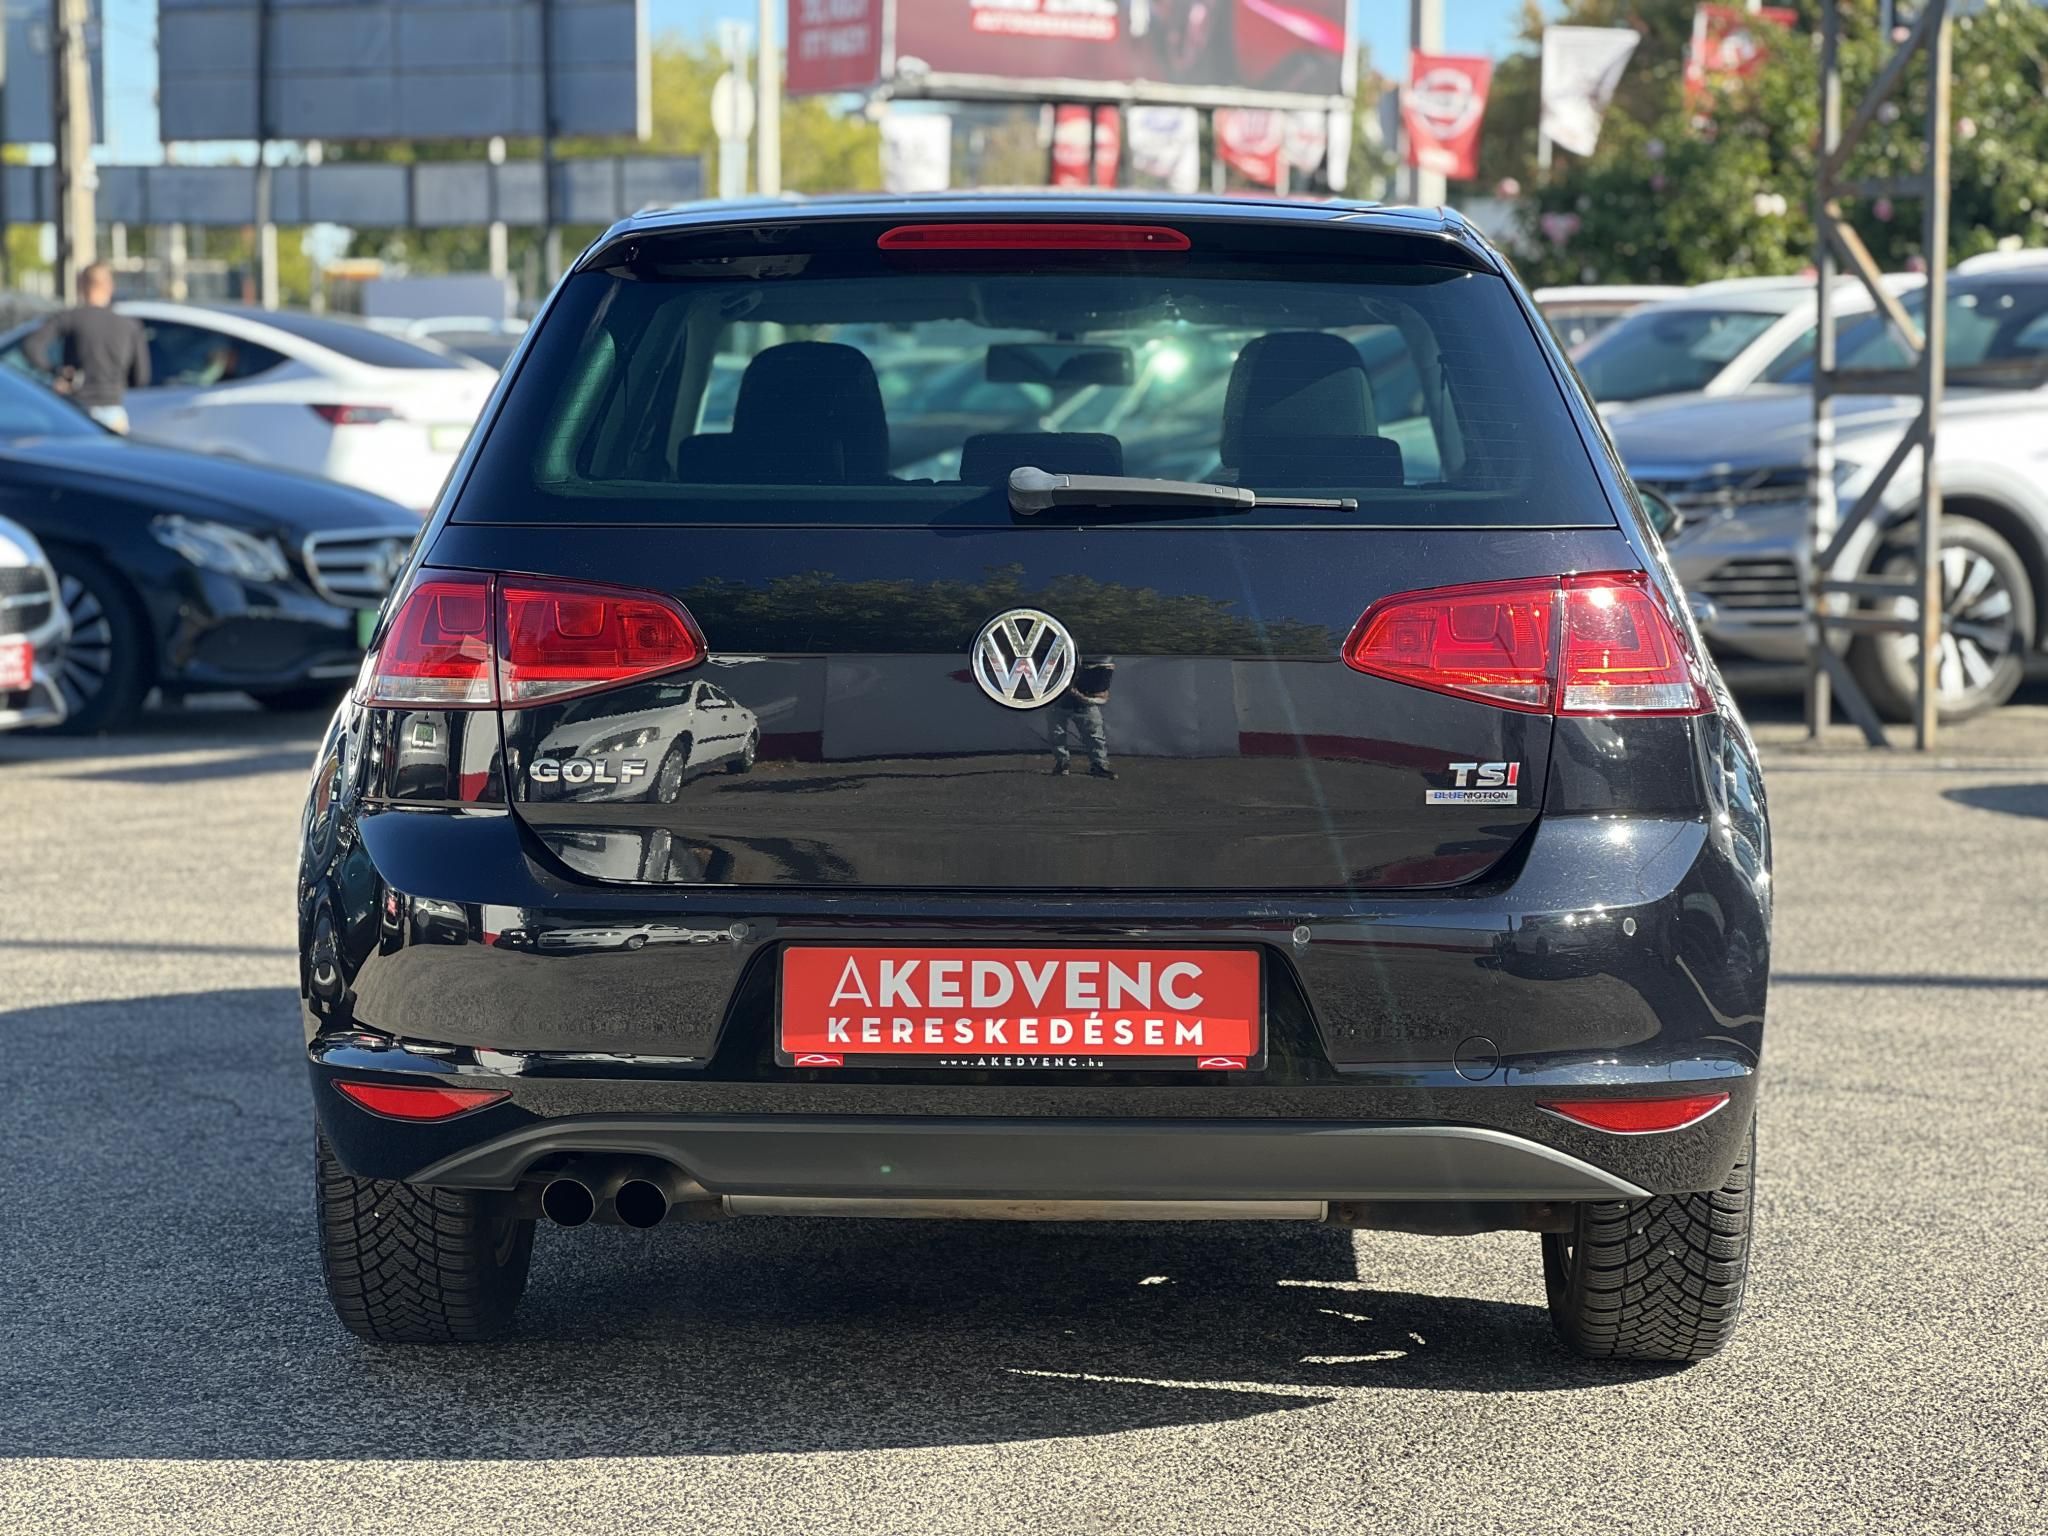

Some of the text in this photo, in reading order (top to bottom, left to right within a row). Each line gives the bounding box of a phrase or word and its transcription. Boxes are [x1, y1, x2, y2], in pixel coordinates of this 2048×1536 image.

[529, 758, 647, 783] GOLF
[1448, 761, 1520, 787] TSI
[1434, 791, 1509, 799] BLUEMOTION
[829, 956, 1204, 1010] AKEDVENC
[827, 1011, 1204, 1046] KERESKEDÉSEM
[940, 1057, 1104, 1067] www.AKEDVENC.hu
